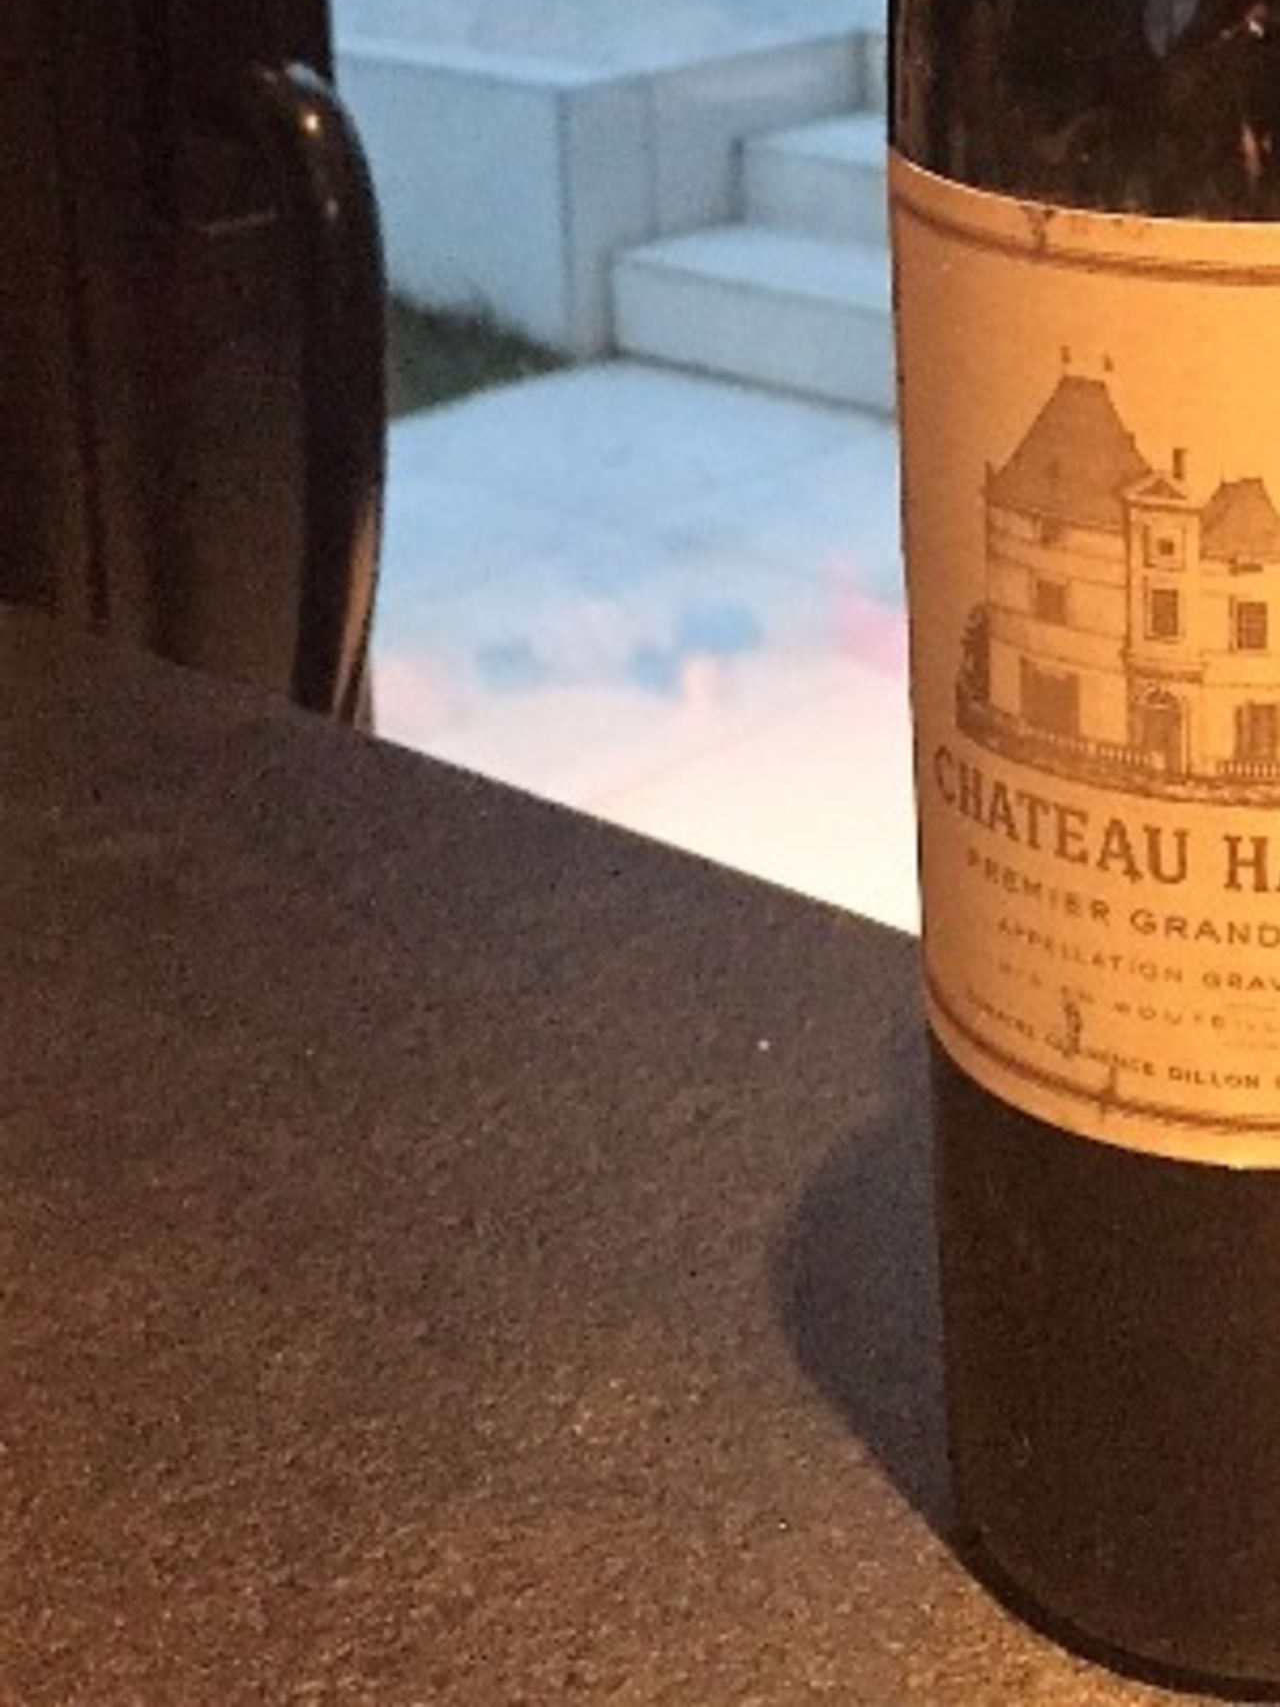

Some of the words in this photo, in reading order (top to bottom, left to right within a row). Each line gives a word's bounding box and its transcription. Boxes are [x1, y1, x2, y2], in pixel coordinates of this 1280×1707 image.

[934, 745, 1189, 884] CHATEAU
[967, 847, 1110, 926] PREMIER
[999, 916, 1183, 984] APPELLATION
[1168, 1065, 1260, 1090] DILLON
